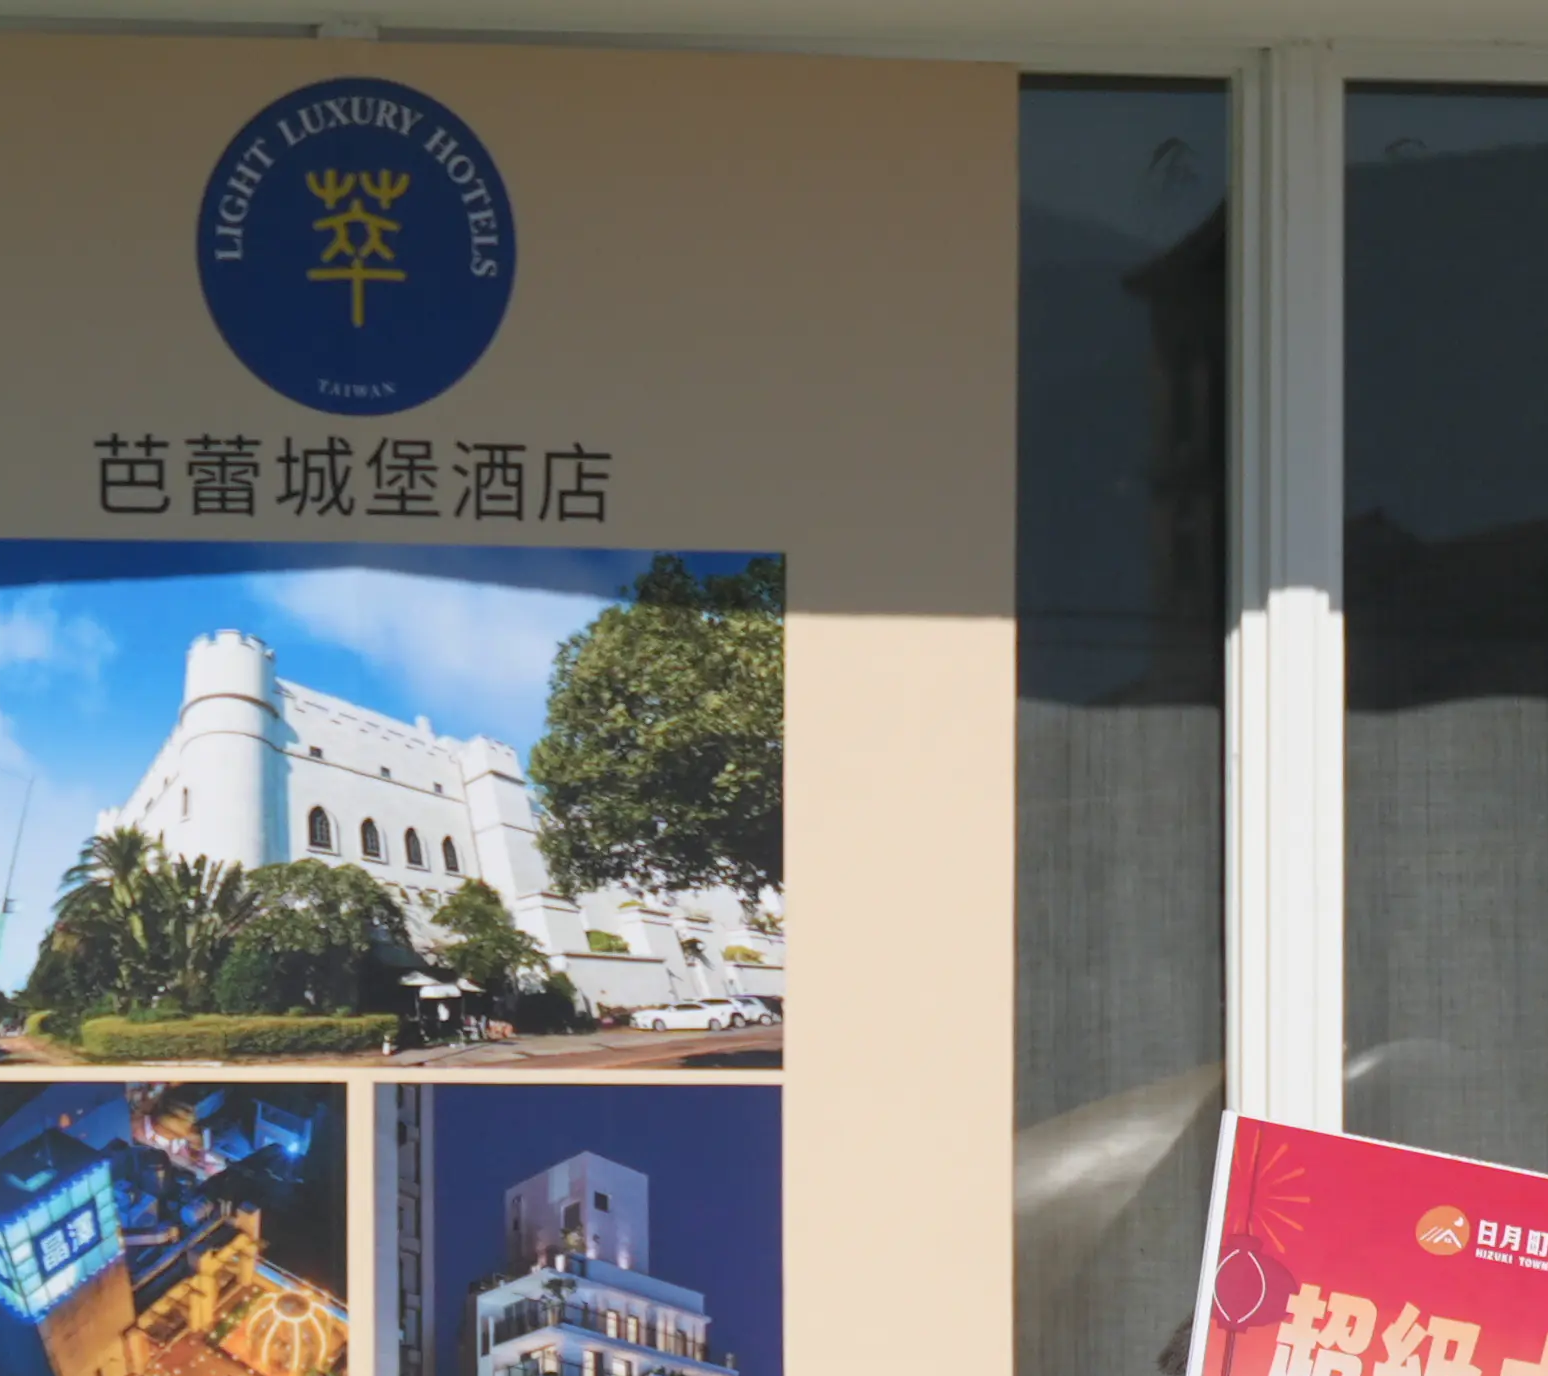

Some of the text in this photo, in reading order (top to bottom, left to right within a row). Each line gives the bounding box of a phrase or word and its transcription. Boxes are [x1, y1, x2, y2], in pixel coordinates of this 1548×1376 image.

[214, 96, 499, 278] LIGHT LUXURY HOTELS
[317, 378, 397, 399] TAIWAN
[93, 432, 613, 523] 芭蕾城堡酒店
[1519, 1256, 1548, 1271] TOWN
